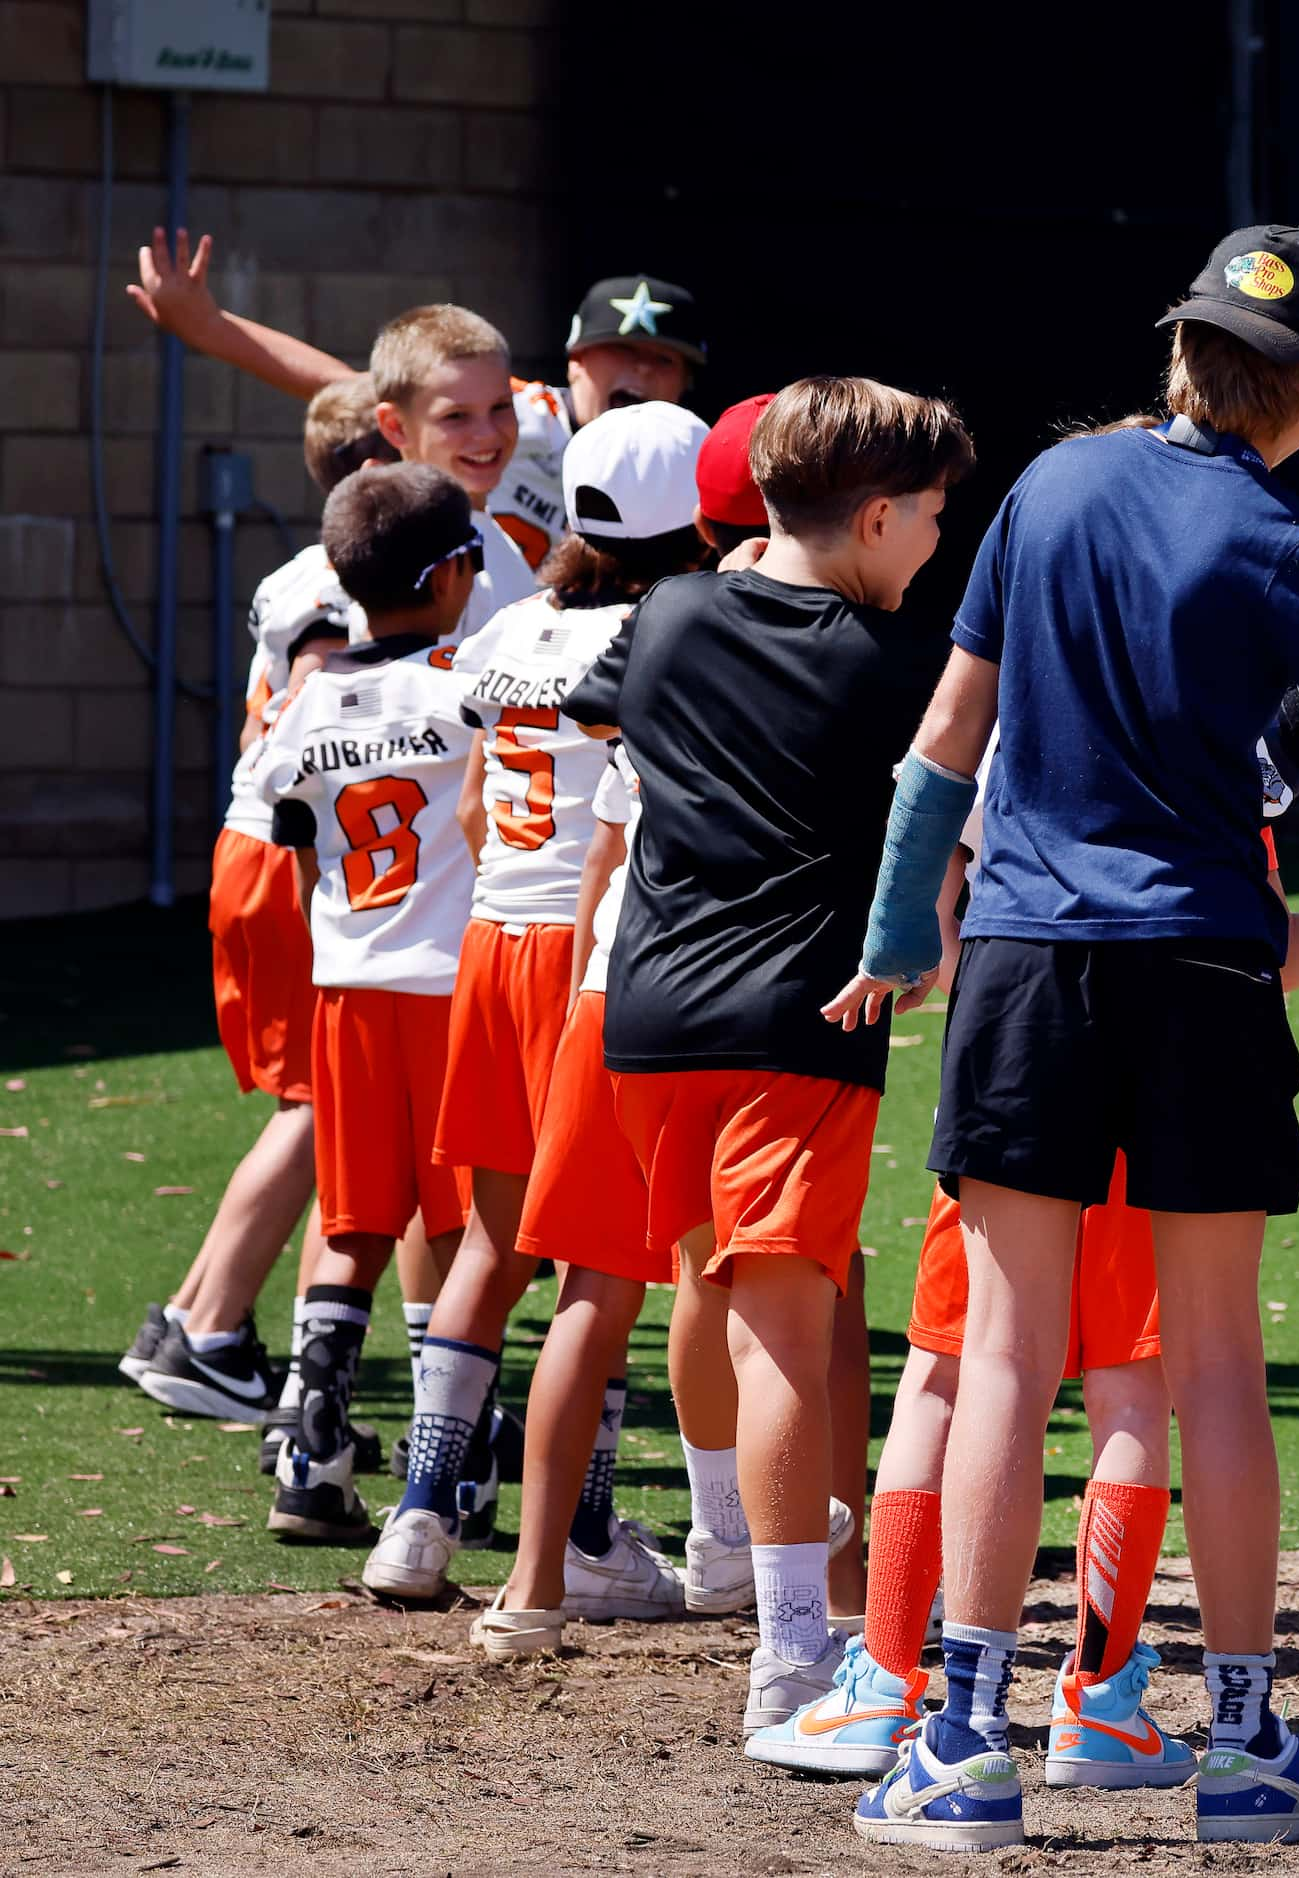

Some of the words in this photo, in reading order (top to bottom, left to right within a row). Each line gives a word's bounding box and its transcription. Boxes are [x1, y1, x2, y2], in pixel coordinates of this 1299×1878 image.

[1254, 265, 1276, 280] Pro
[1257, 252, 1286, 273] Bass
[1253, 277, 1286, 297] Shops
[473, 669, 567, 709] ROBLES
[490, 705, 559, 851] 5
[334, 774, 429, 912] 8
[982, 1757, 1010, 1776] NIKE
[1205, 1754, 1236, 1770] NIKE
